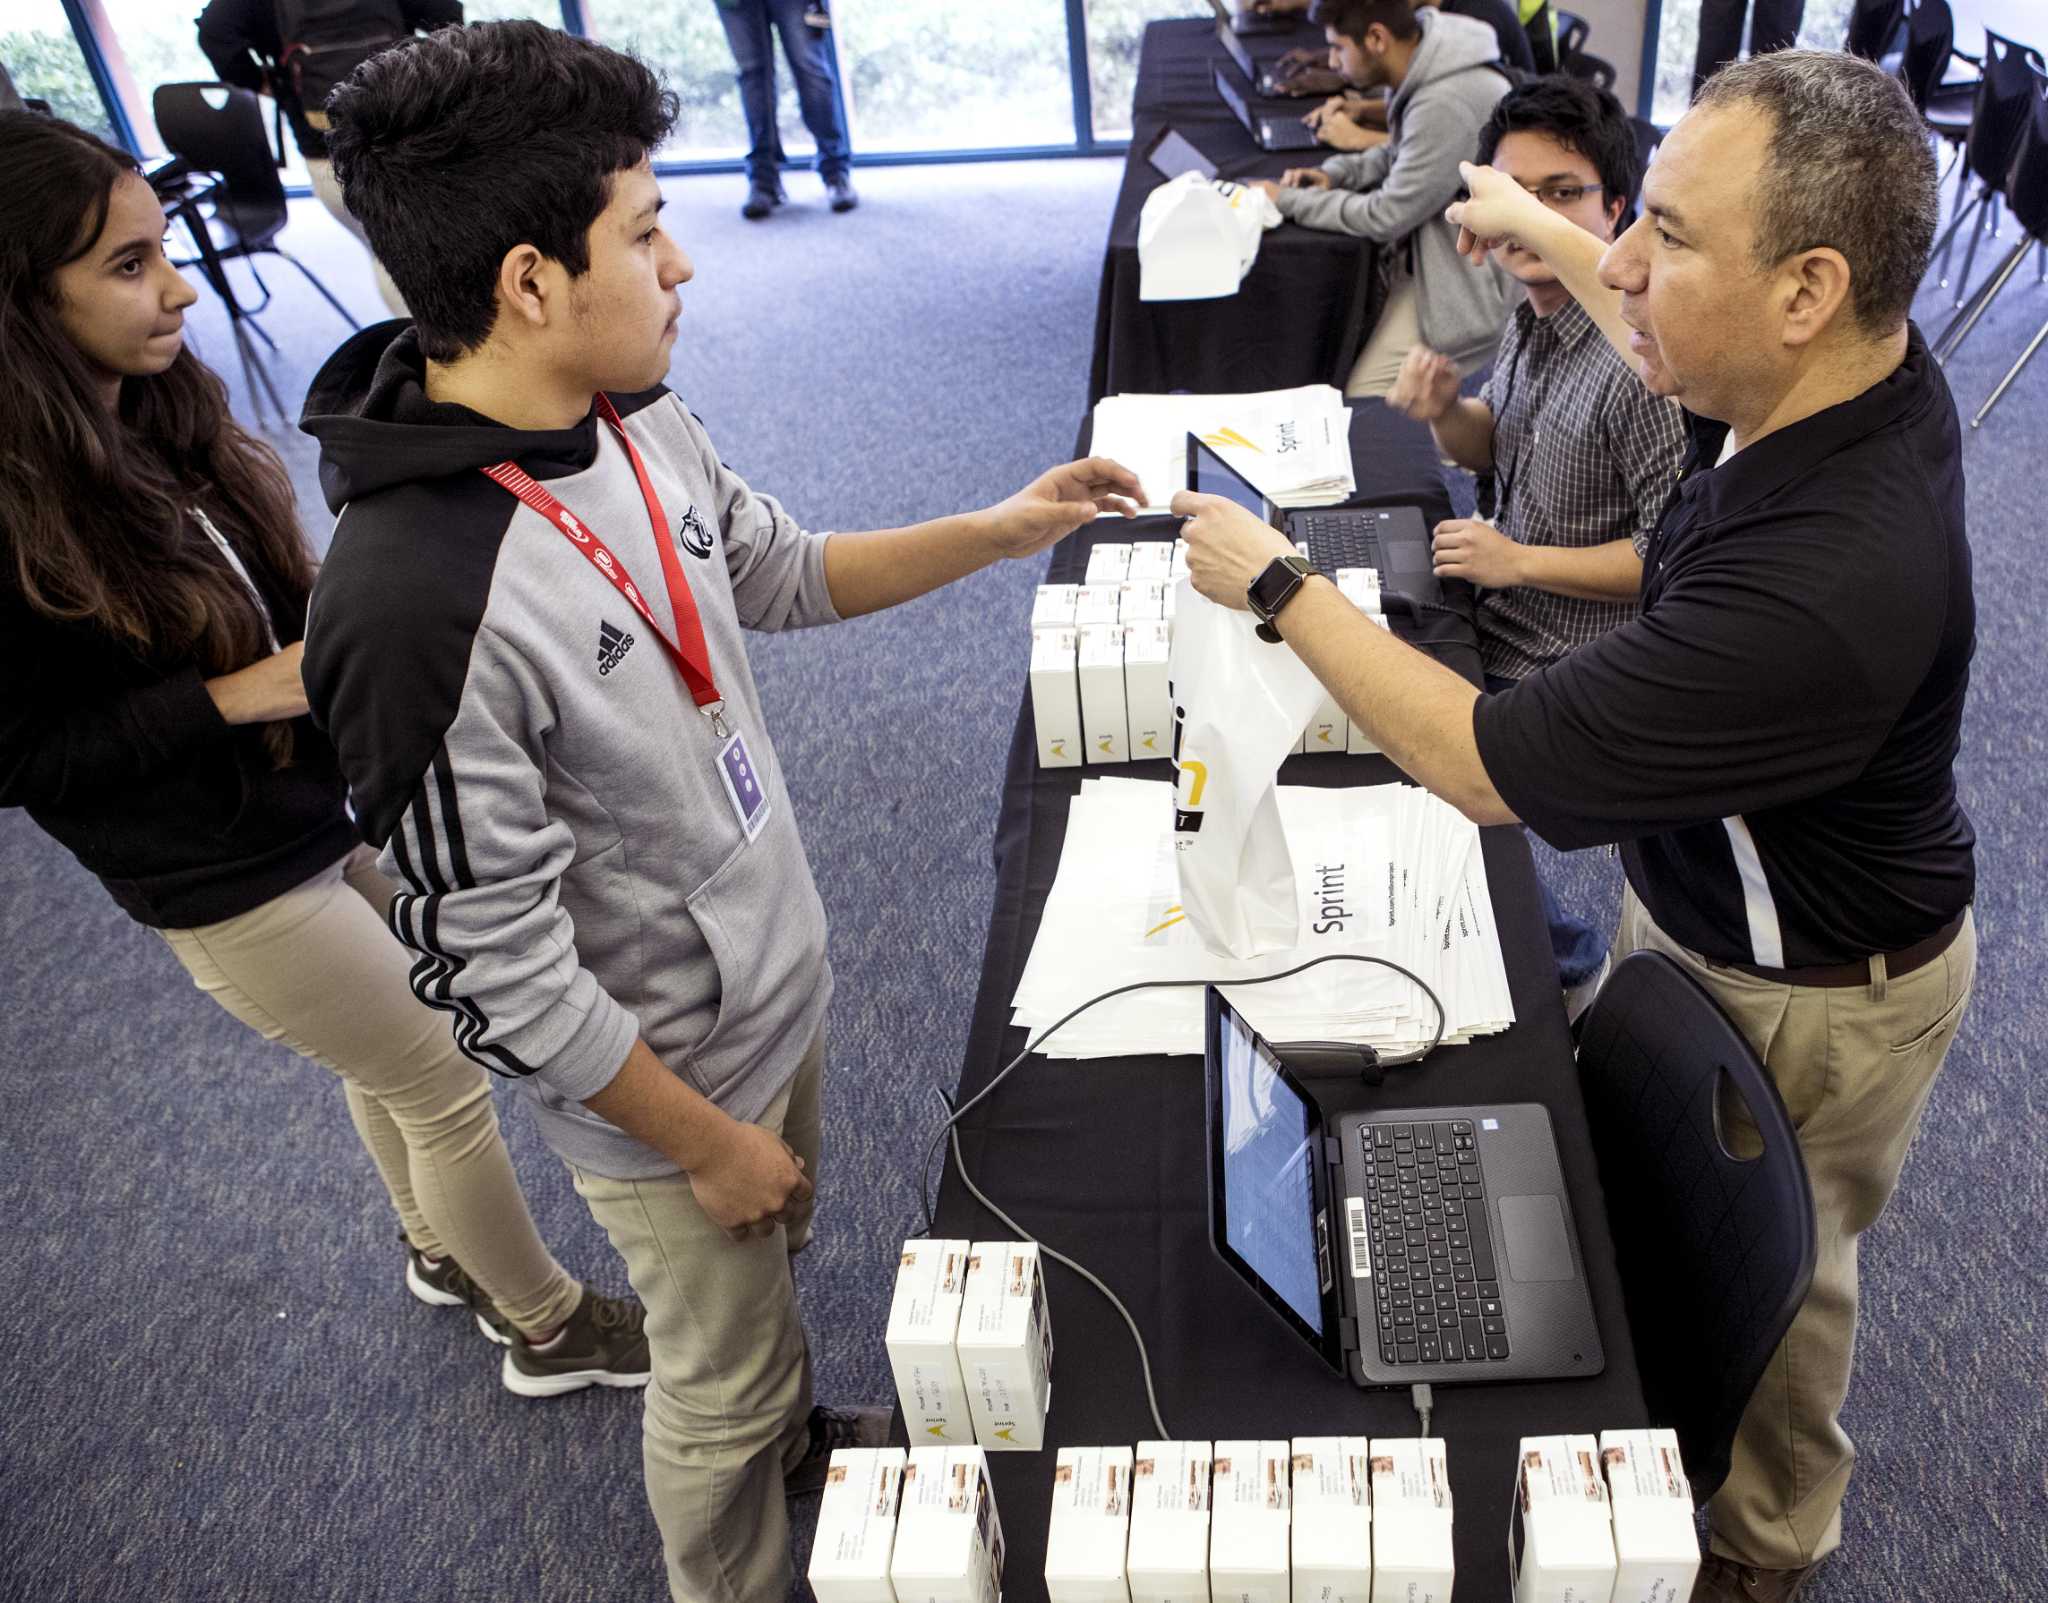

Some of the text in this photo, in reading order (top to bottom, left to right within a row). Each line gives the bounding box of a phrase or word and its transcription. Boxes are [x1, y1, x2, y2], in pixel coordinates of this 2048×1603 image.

[1276, 420, 1301, 454] Sprint
[599, 633, 634, 675] adidas
[1313, 863, 1352, 934] Sprint
